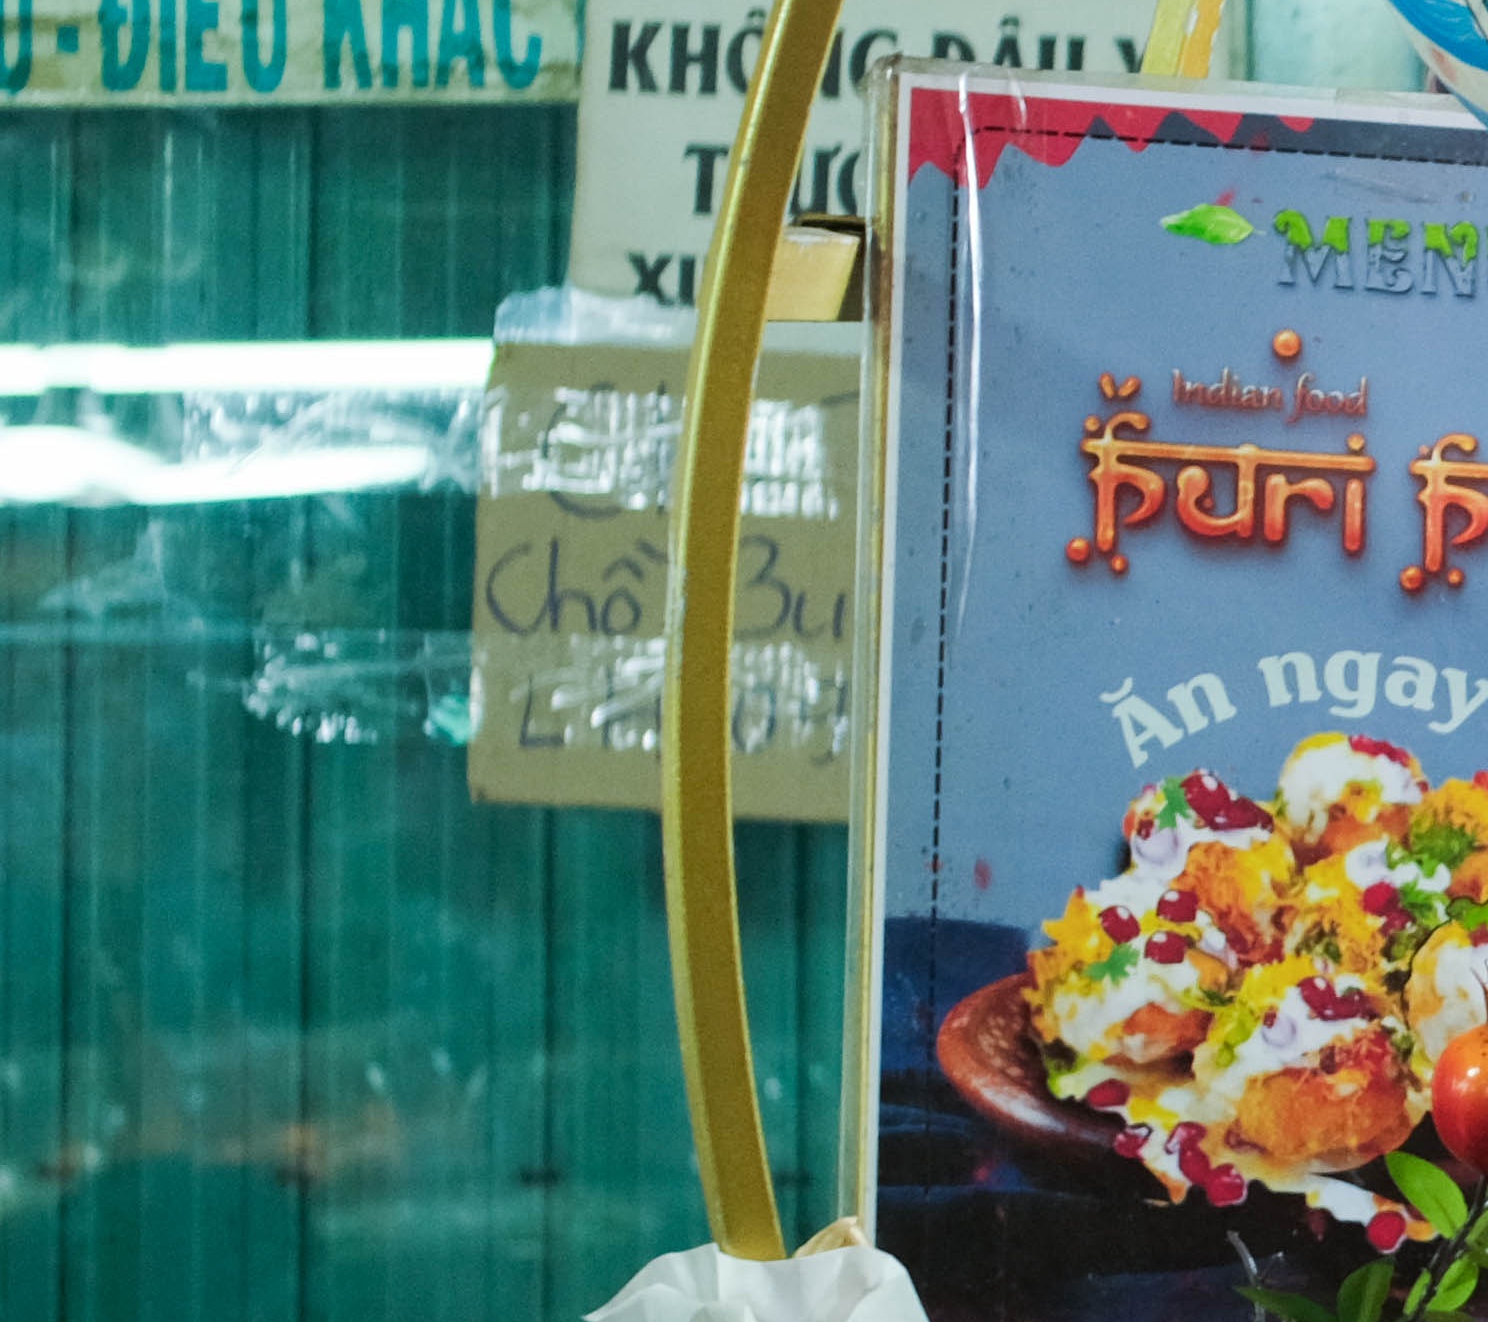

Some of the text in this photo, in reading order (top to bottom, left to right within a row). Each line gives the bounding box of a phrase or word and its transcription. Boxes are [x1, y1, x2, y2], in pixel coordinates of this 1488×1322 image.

[1172, 369, 1369, 423] Indian food
[1100, 671, 1238, 769] Ăn
